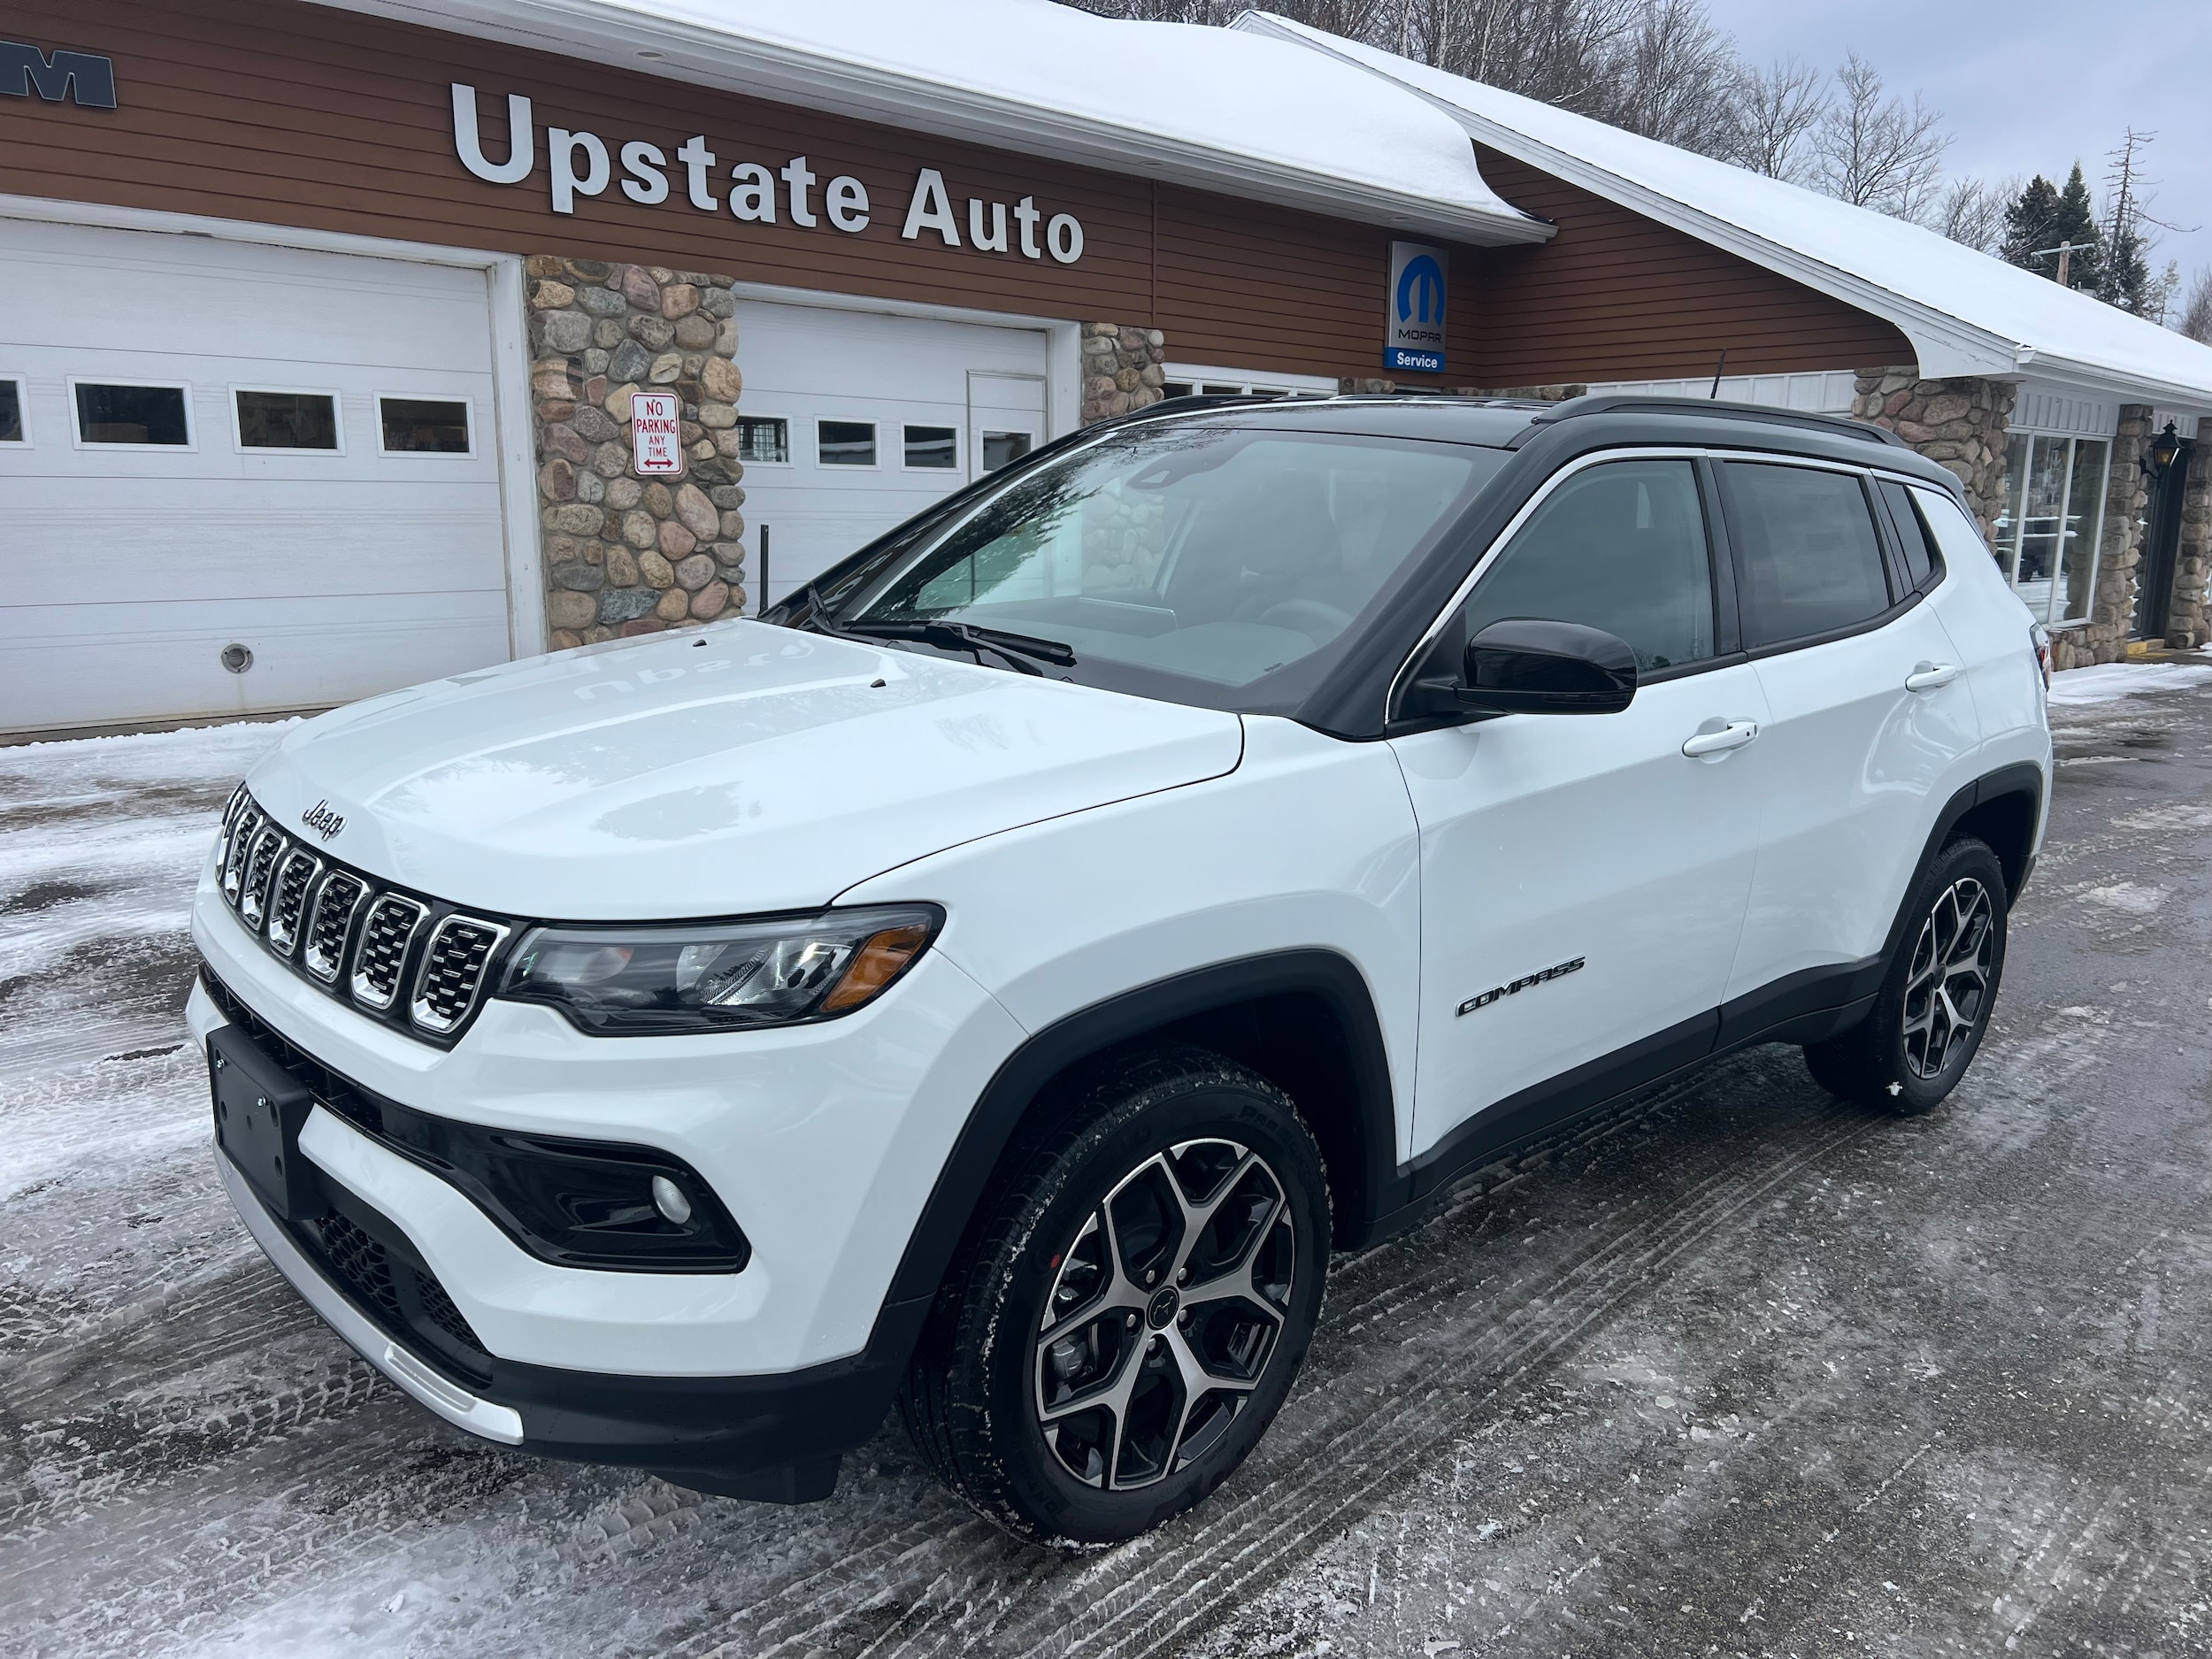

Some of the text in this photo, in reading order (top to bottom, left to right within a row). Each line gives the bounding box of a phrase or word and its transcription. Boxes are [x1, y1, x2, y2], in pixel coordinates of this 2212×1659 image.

[451, 83, 1085, 264] Upstate Auto
[1398, 328, 1441, 343] MOPAR
[1396, 351, 1438, 369] Service
[646, 401, 664, 416] NO
[636, 419, 676, 434] PARKING
[649, 435, 665, 445] ANY
[648, 447, 668, 457] TIME
[302, 799, 348, 842] Jeep
[1455, 955, 1586, 1017] COMPASS
